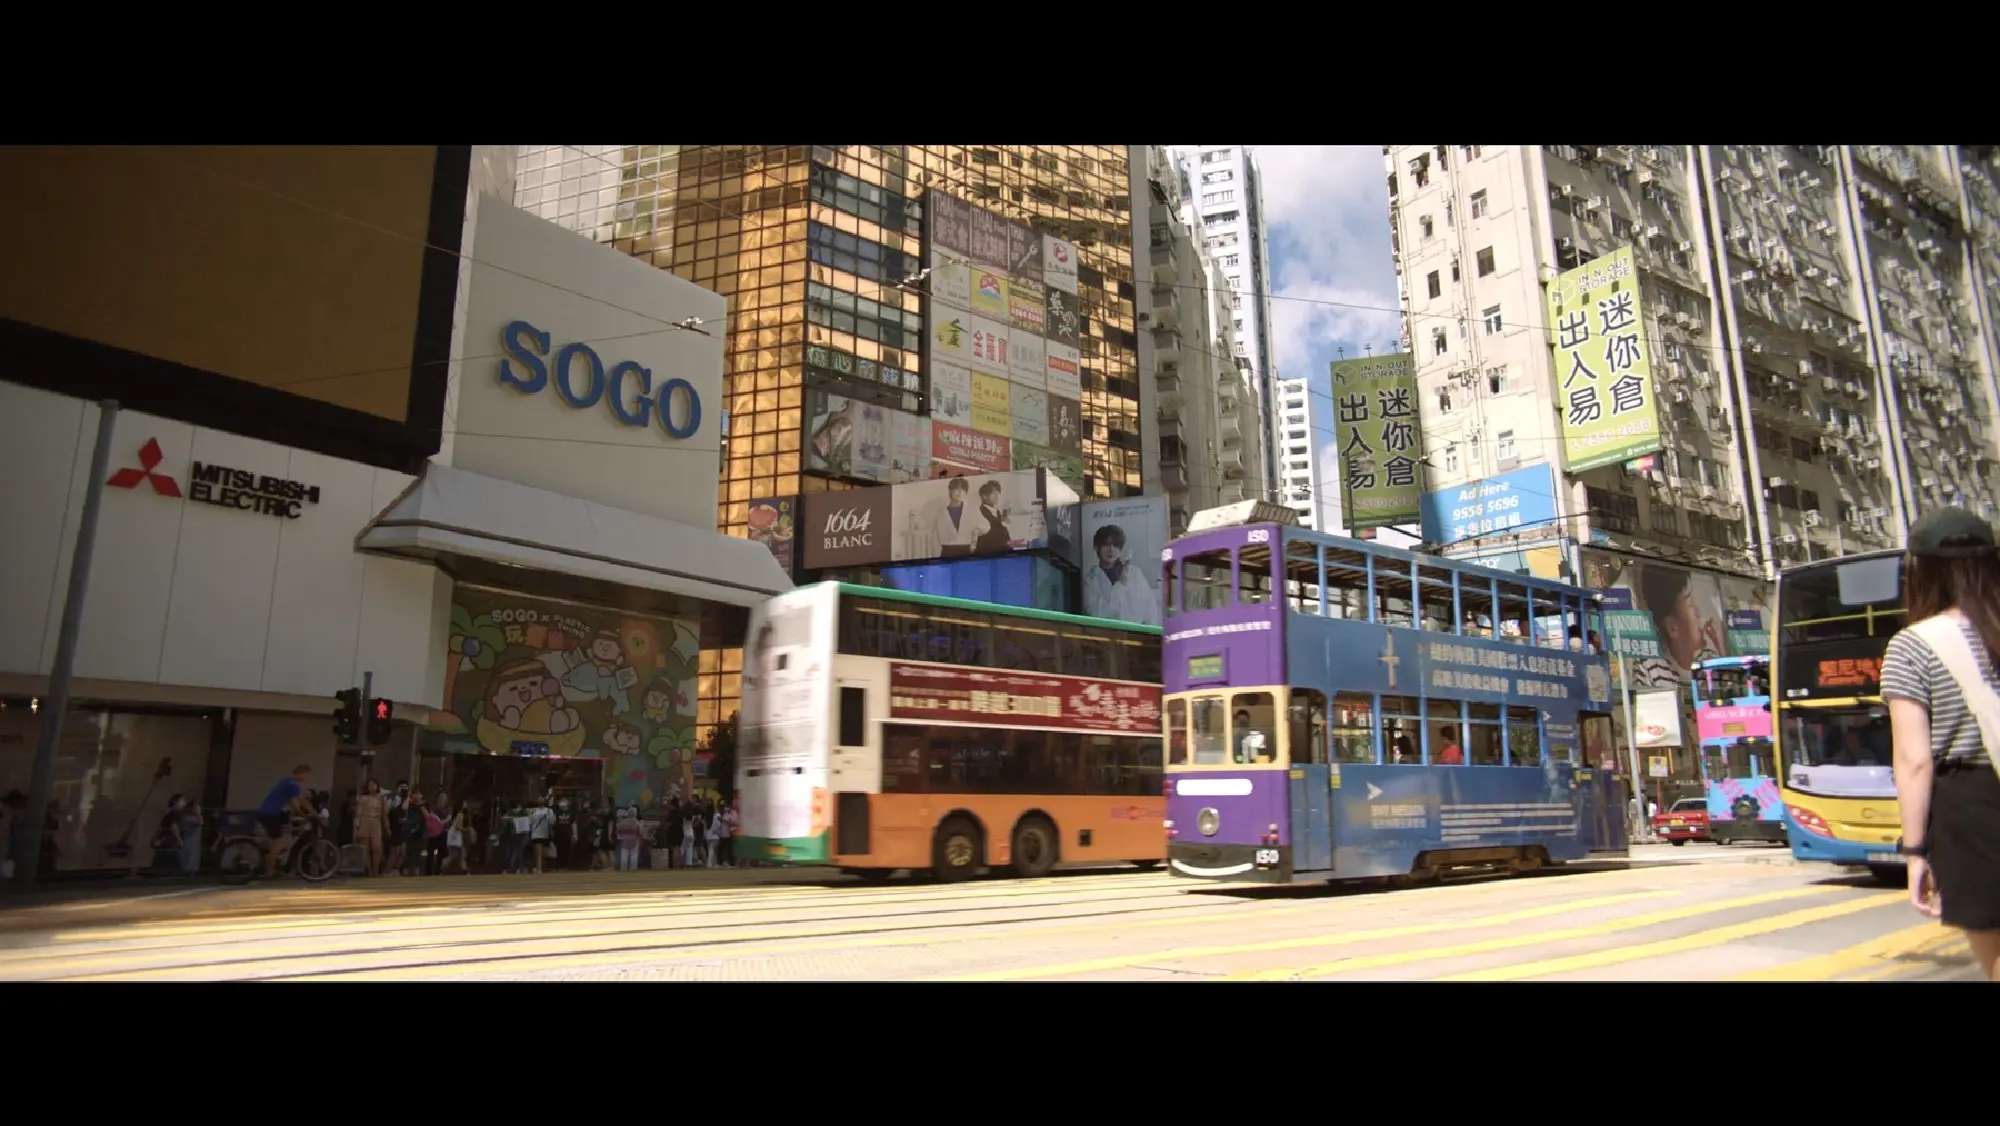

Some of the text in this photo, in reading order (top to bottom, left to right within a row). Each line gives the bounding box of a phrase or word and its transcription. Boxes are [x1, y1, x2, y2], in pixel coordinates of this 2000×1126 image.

[1607, 257, 1629, 272] OUT
[1579, 267, 1630, 293] STORAGE
[1599, 291, 1645, 416] 迷你倉
[498, 320, 702, 440] SOGO
[1360, 367, 1409, 380] STORAGE
[1559, 310, 1601, 426] 出入易
[1340, 393, 1378, 490] 出入易
[1379, 387, 1416, 488] 迷你倉
[191, 460, 320, 504] MITSUBISHI
[1459, 481, 1509, 502] Ad Here
[188, 481, 303, 520] ELECTRIC
[1487, 496, 1519, 512] 5696
[824, 508, 871, 534] 1664
[824, 534, 872, 549] BLANC
[492, 609, 538, 622] SOGO
